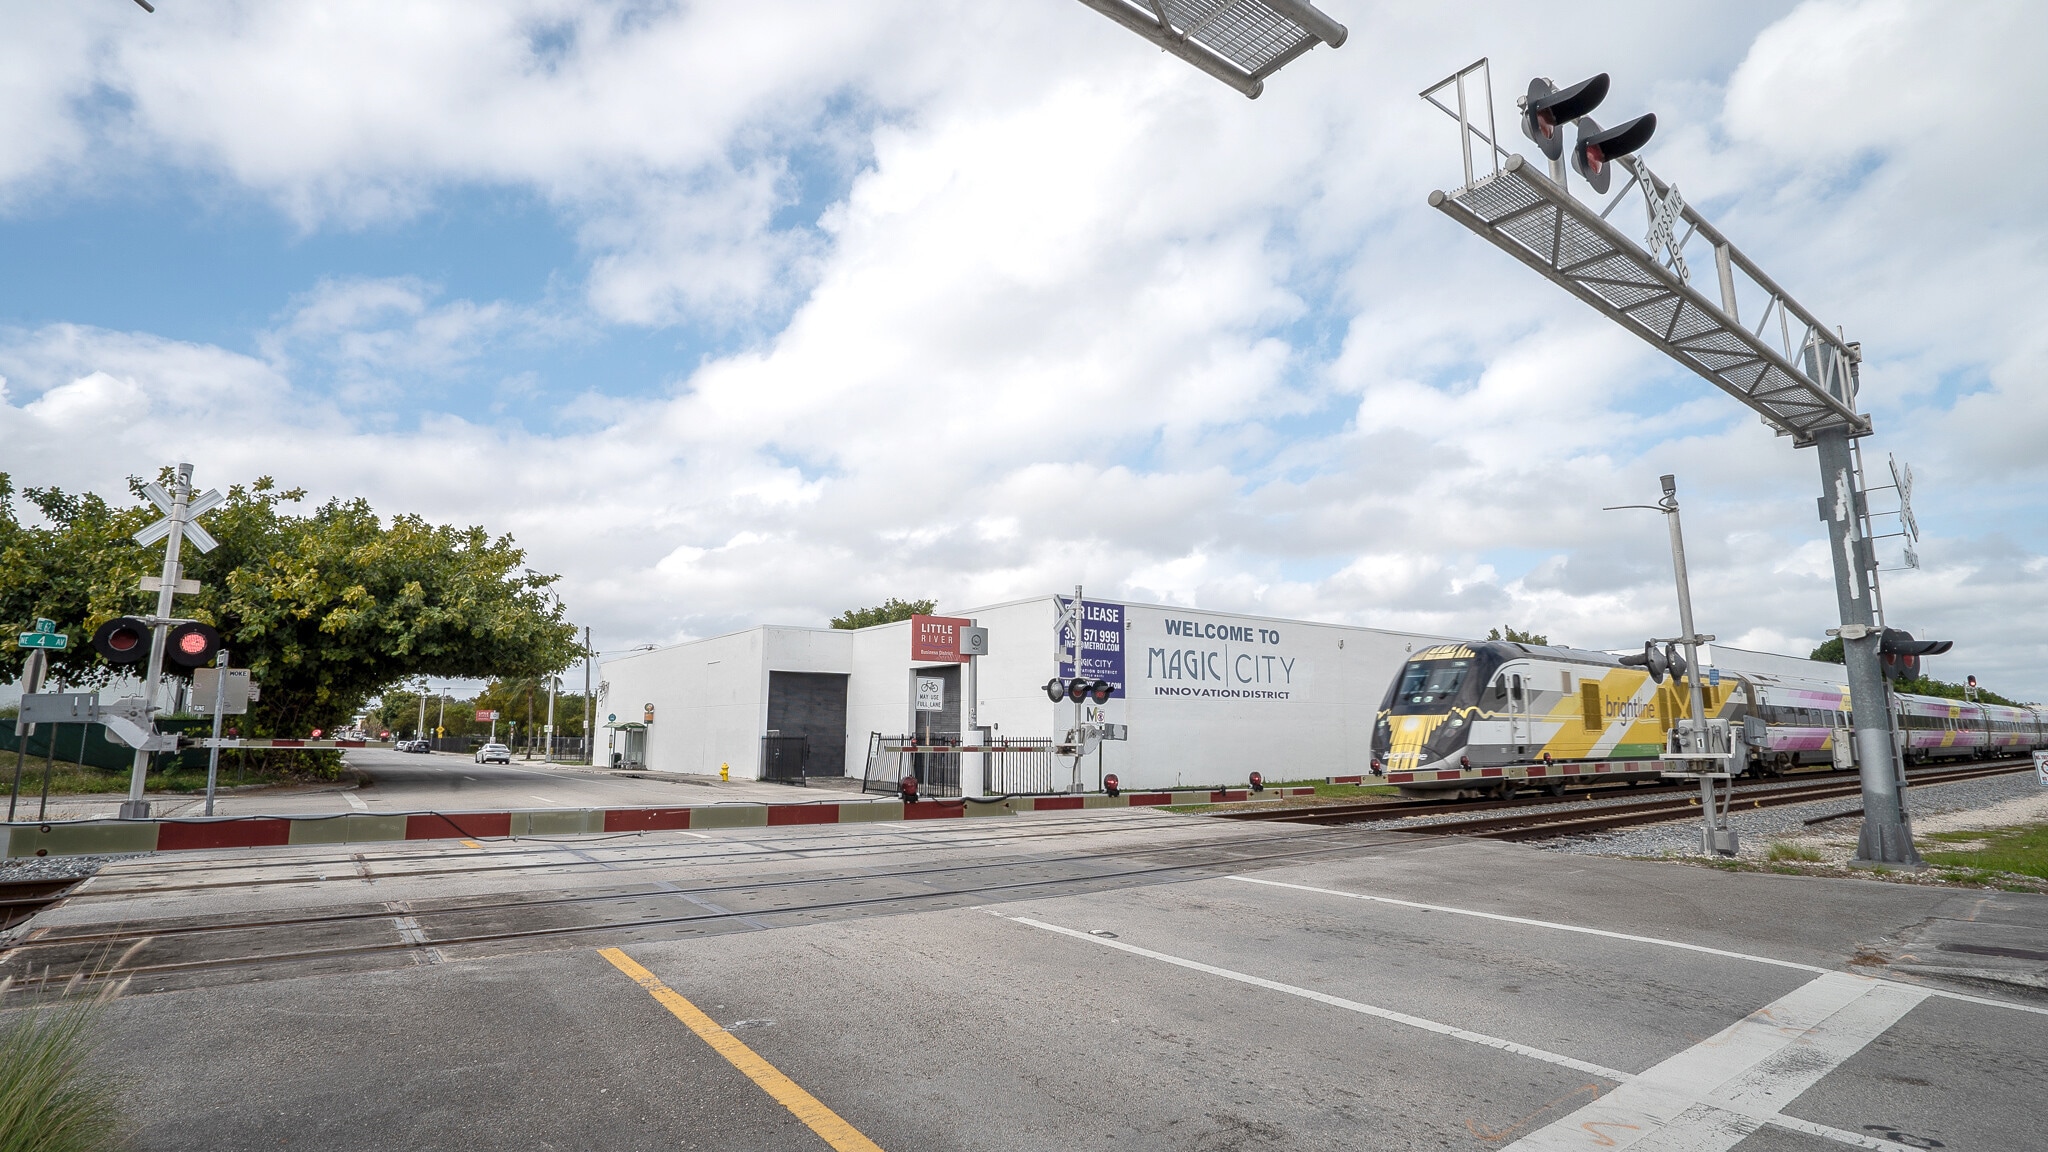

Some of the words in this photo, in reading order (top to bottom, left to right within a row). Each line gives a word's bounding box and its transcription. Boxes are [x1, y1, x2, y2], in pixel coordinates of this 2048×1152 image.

[1637, 161, 1659, 212] RAIL
[1649, 190, 1682, 254] CROSSING
[1666, 232, 1689, 279] ROAD
[1087, 606, 1119, 622] LEASE
[921, 623, 953, 635] LITTLE
[1084, 628, 1098, 642] 571
[1100, 630, 1120, 643] 9991
[1165, 619, 1254, 643] WELCOME
[1258, 629, 1280, 645] TO
[20, 636, 29, 644] NE
[37, 635, 46, 646] 4
[56, 638, 65, 646] AV
[921, 634, 953, 644] RIVER
[1095, 659, 1112, 668] CITY
[1147, 647, 1221, 681] MAGIC
[1235, 653, 1295, 684] CITY
[1154, 686, 1240, 698] INNOVATION
[1242, 690, 1290, 700] DISTRICT
[1605, 694, 1655, 727] brightline
[1697, 738, 1703, 748] 1
